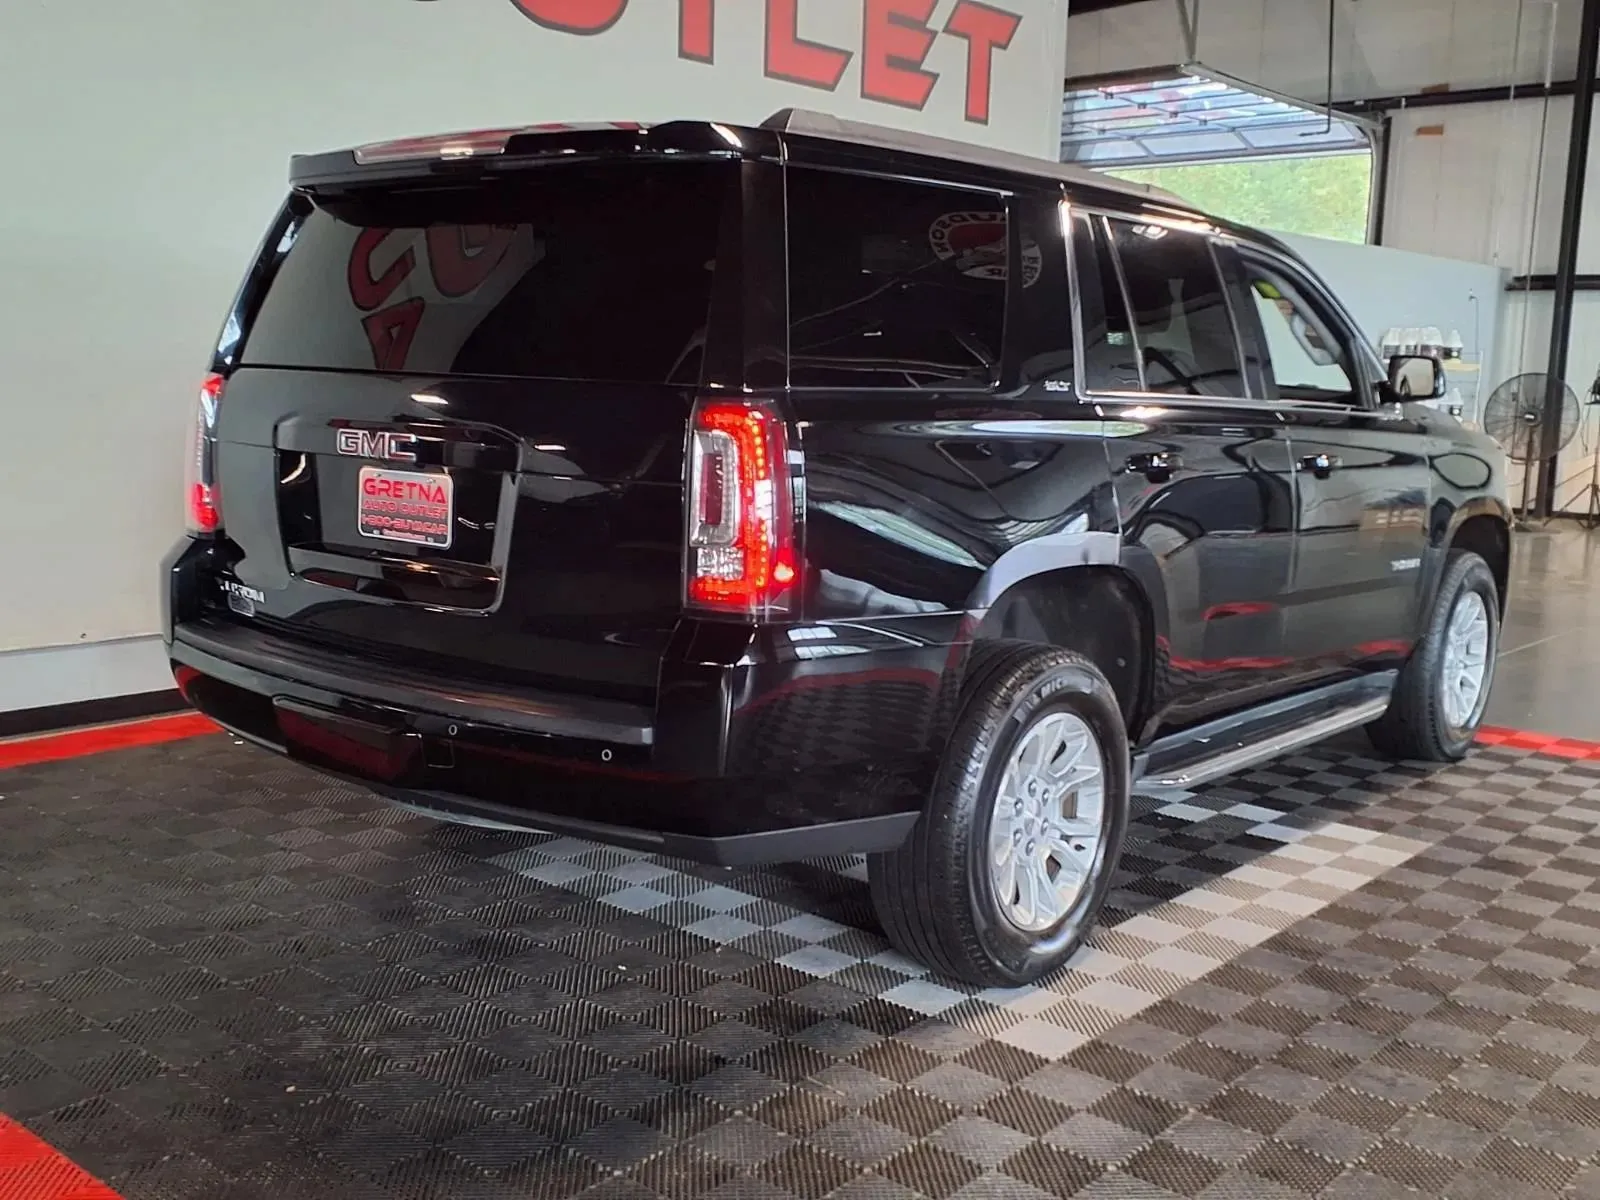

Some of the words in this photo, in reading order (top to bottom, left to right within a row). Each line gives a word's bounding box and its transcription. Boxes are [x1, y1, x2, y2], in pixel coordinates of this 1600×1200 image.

[337, 428, 418, 461] GMC
[363, 477, 447, 504] GRETNA
[363, 499, 397, 513] AUTO
[400, 502, 449, 519] OUTLET
